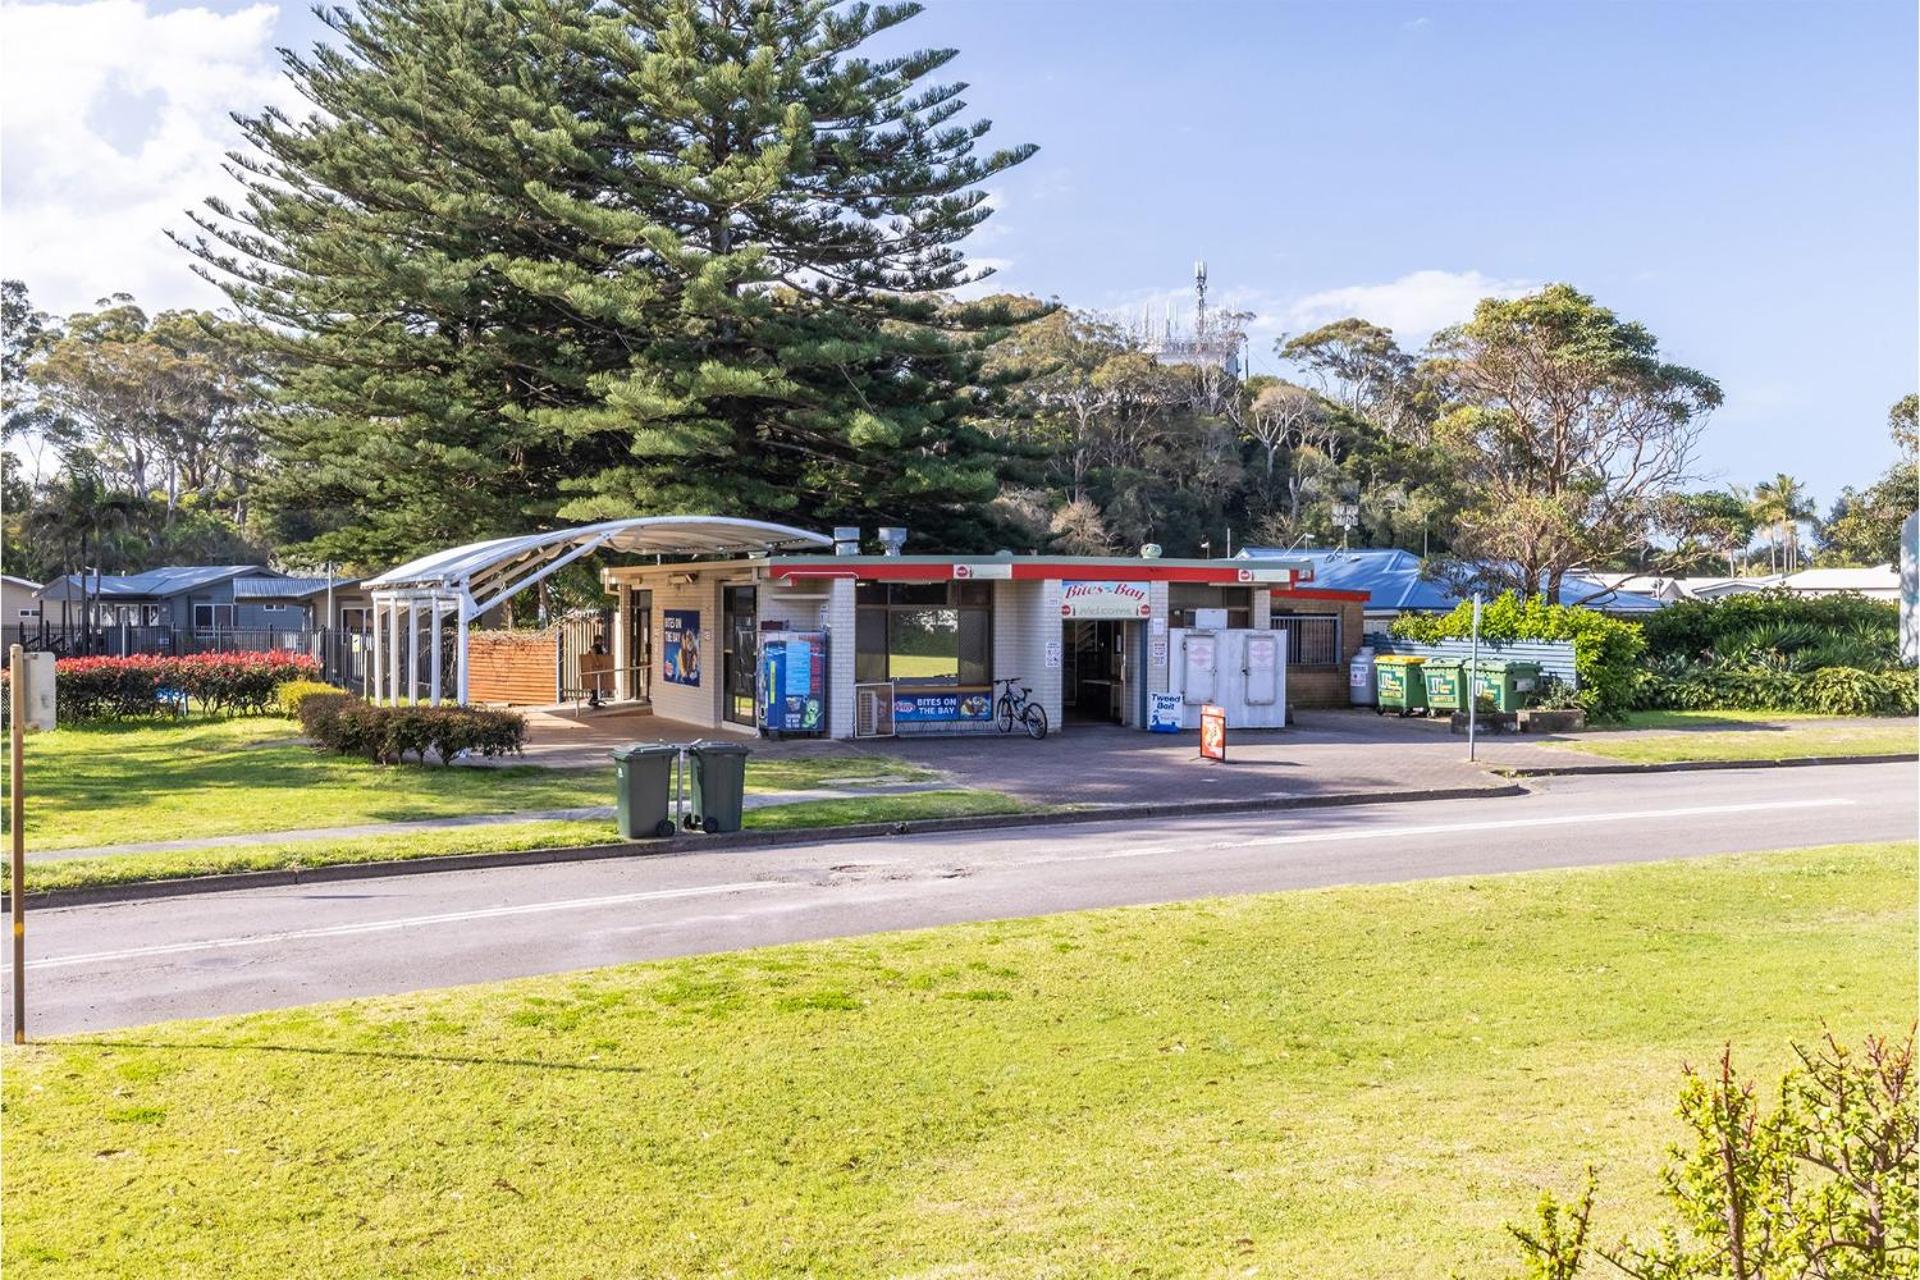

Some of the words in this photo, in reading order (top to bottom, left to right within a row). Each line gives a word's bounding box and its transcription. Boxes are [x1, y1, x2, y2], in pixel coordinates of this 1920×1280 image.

[1114, 583, 1145, 600] Bay
[917, 698, 941, 706] BITES
[943, 698, 957, 706] ON
[1151, 693, 1181, 703] Tweed
[1156, 702, 1175, 710] Bait
